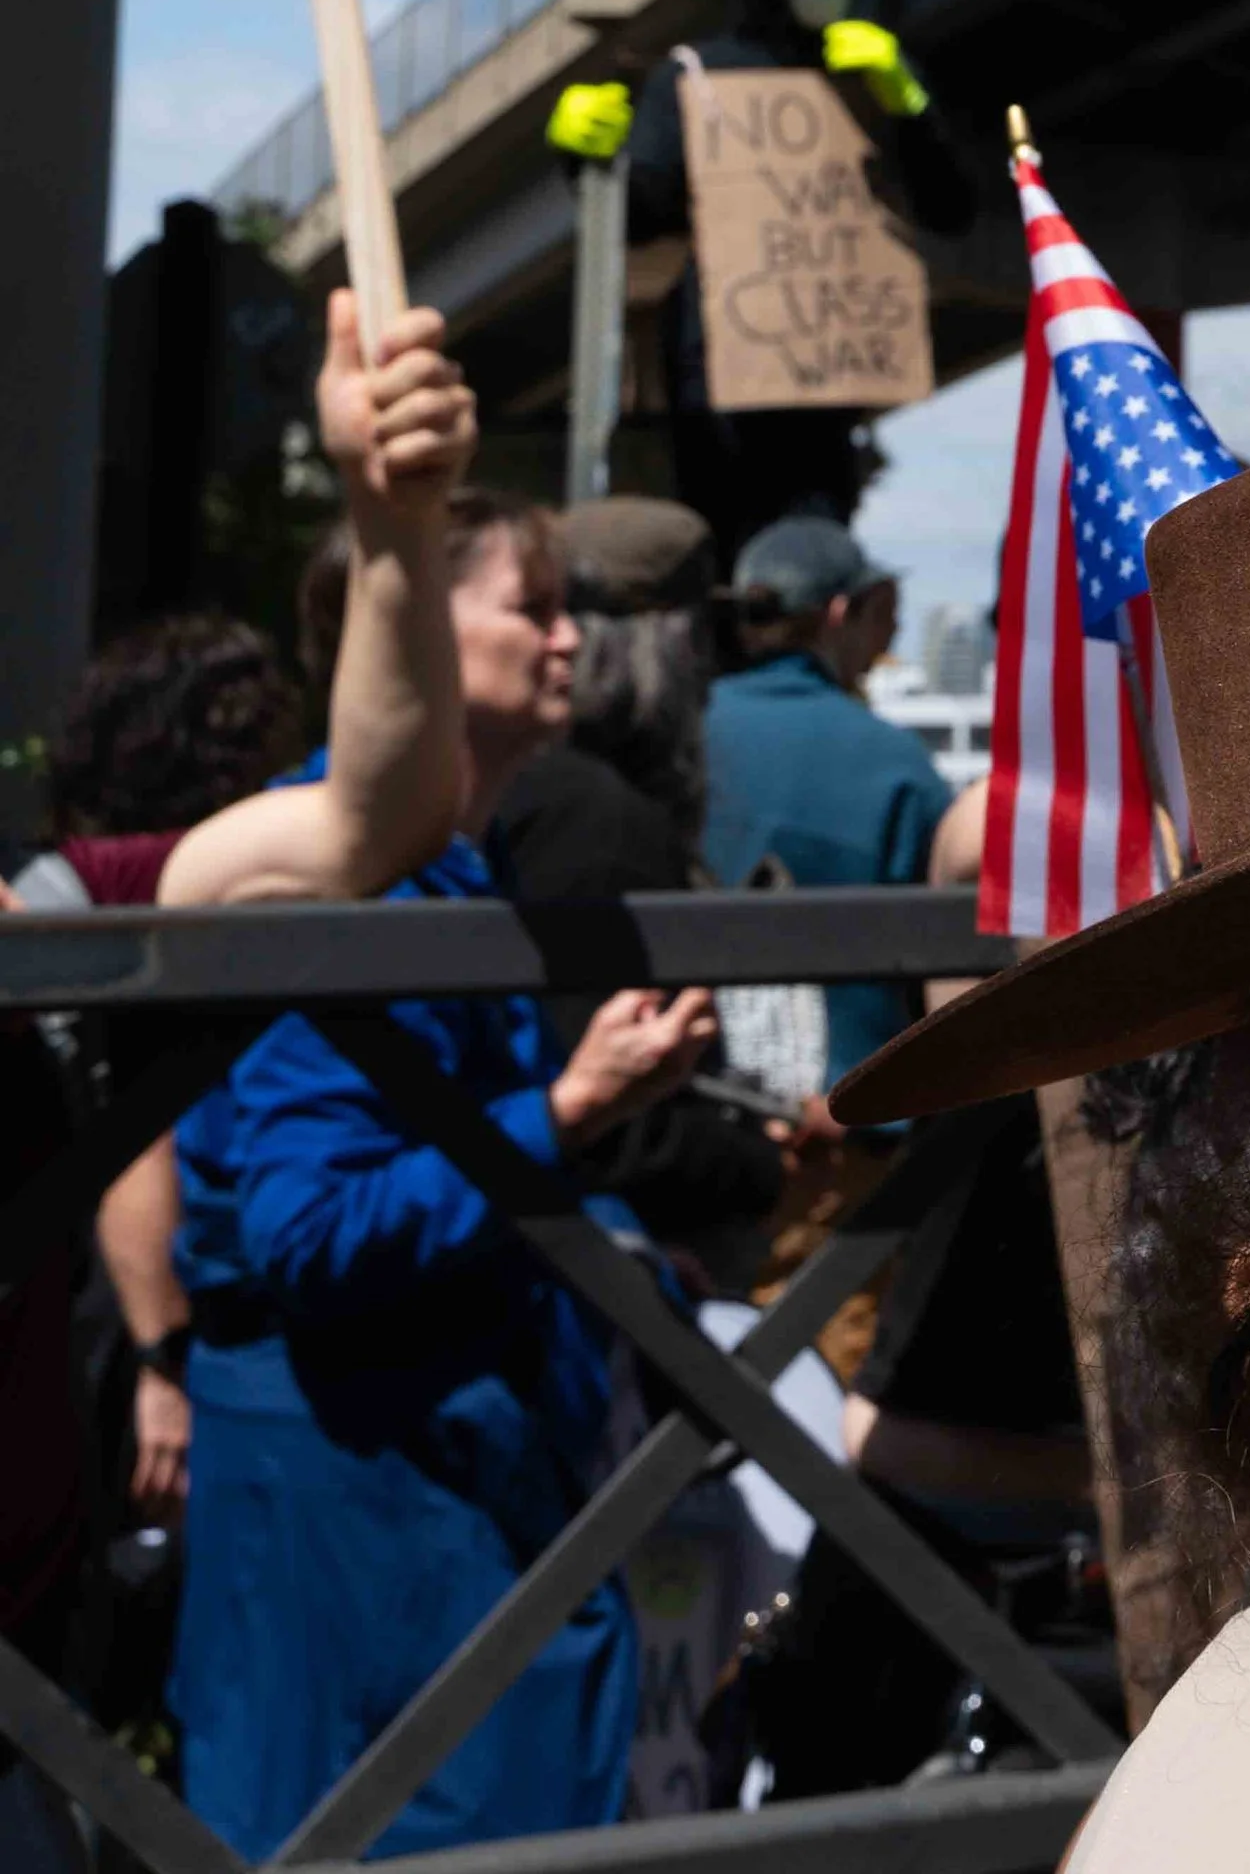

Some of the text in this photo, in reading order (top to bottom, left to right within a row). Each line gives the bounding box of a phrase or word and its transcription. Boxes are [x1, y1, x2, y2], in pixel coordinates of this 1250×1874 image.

[705, 91, 820, 161] NO
[761, 219, 861, 272] BUT
[725, 271, 910, 344] CLASS
[776, 333, 903, 387] WAR
